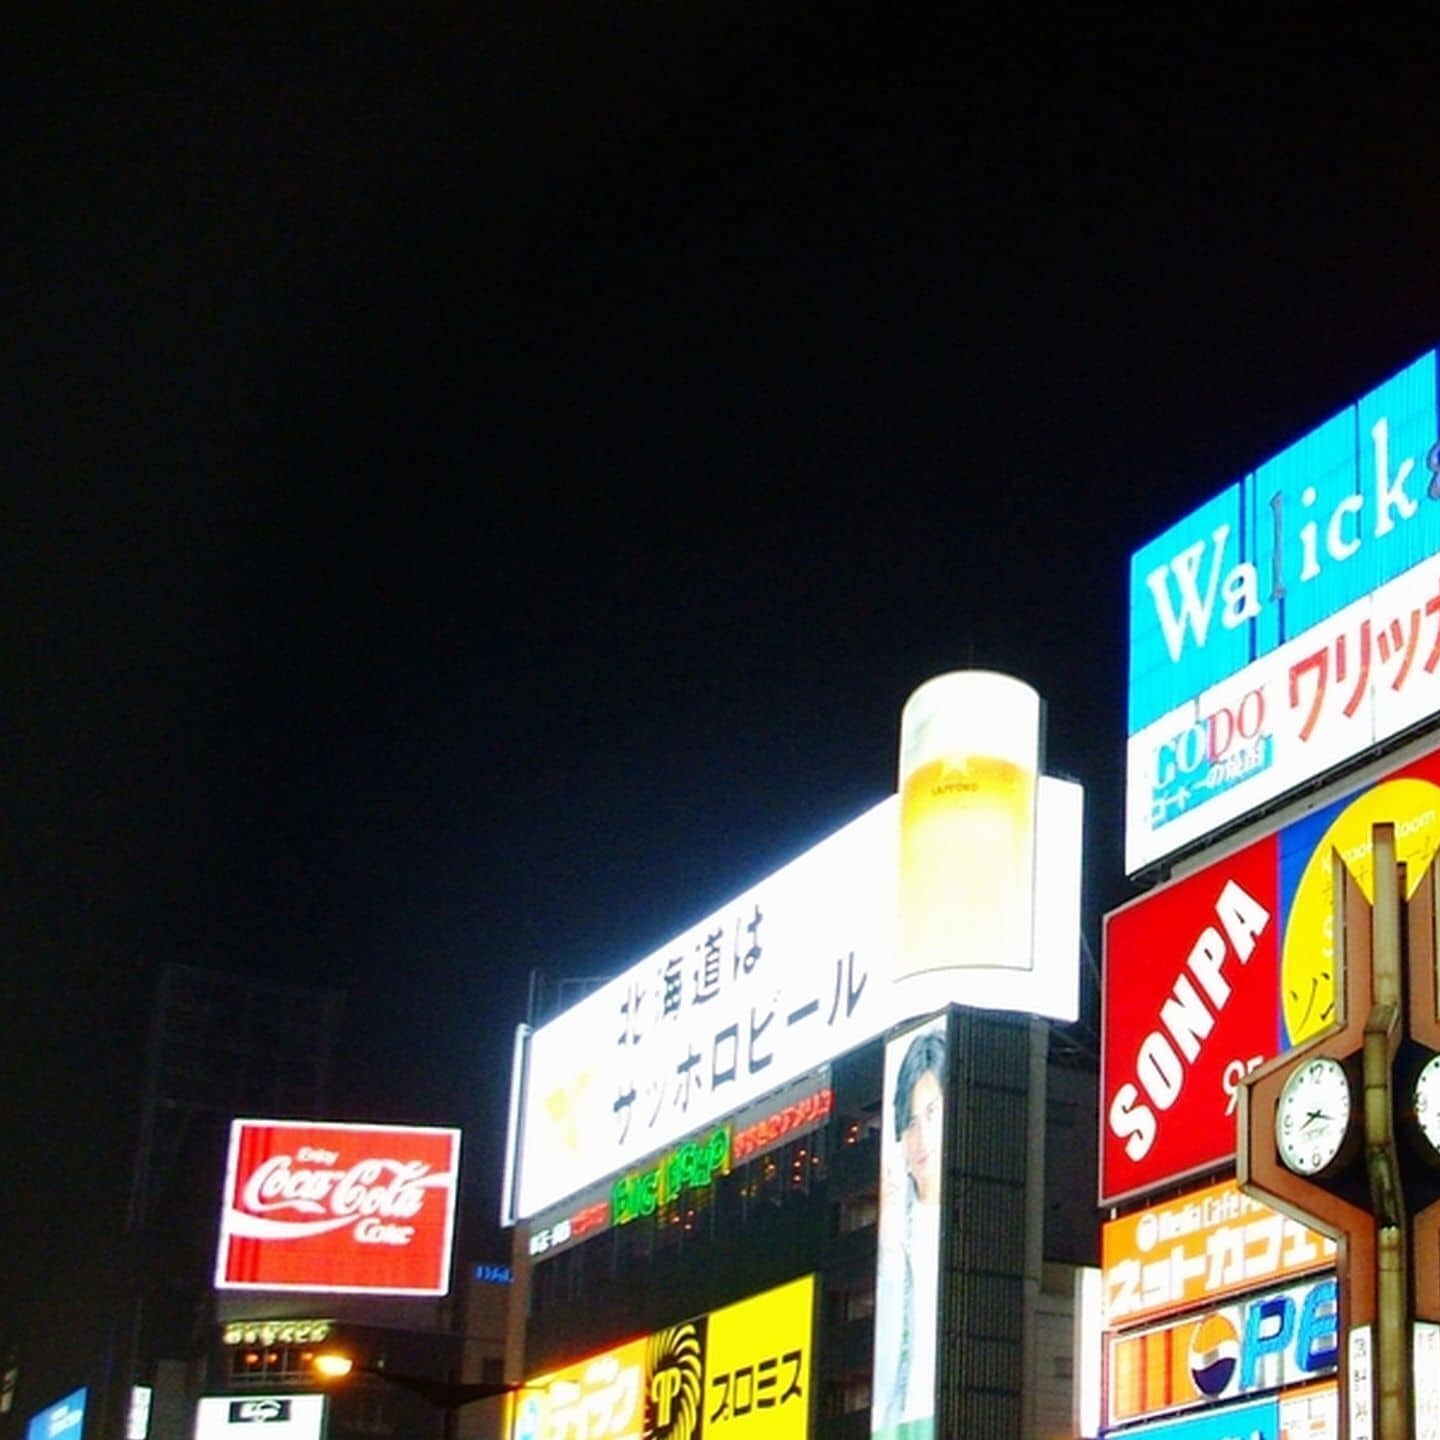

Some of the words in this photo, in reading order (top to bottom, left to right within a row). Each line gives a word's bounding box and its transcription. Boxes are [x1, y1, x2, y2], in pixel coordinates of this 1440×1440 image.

[616, 903, 765, 1047] 北海道は
[1108, 879, 1270, 1163] SONPA
[242, 1155, 432, 1219] Coca-Cola
[354, 1217, 416, 1246] Coke
